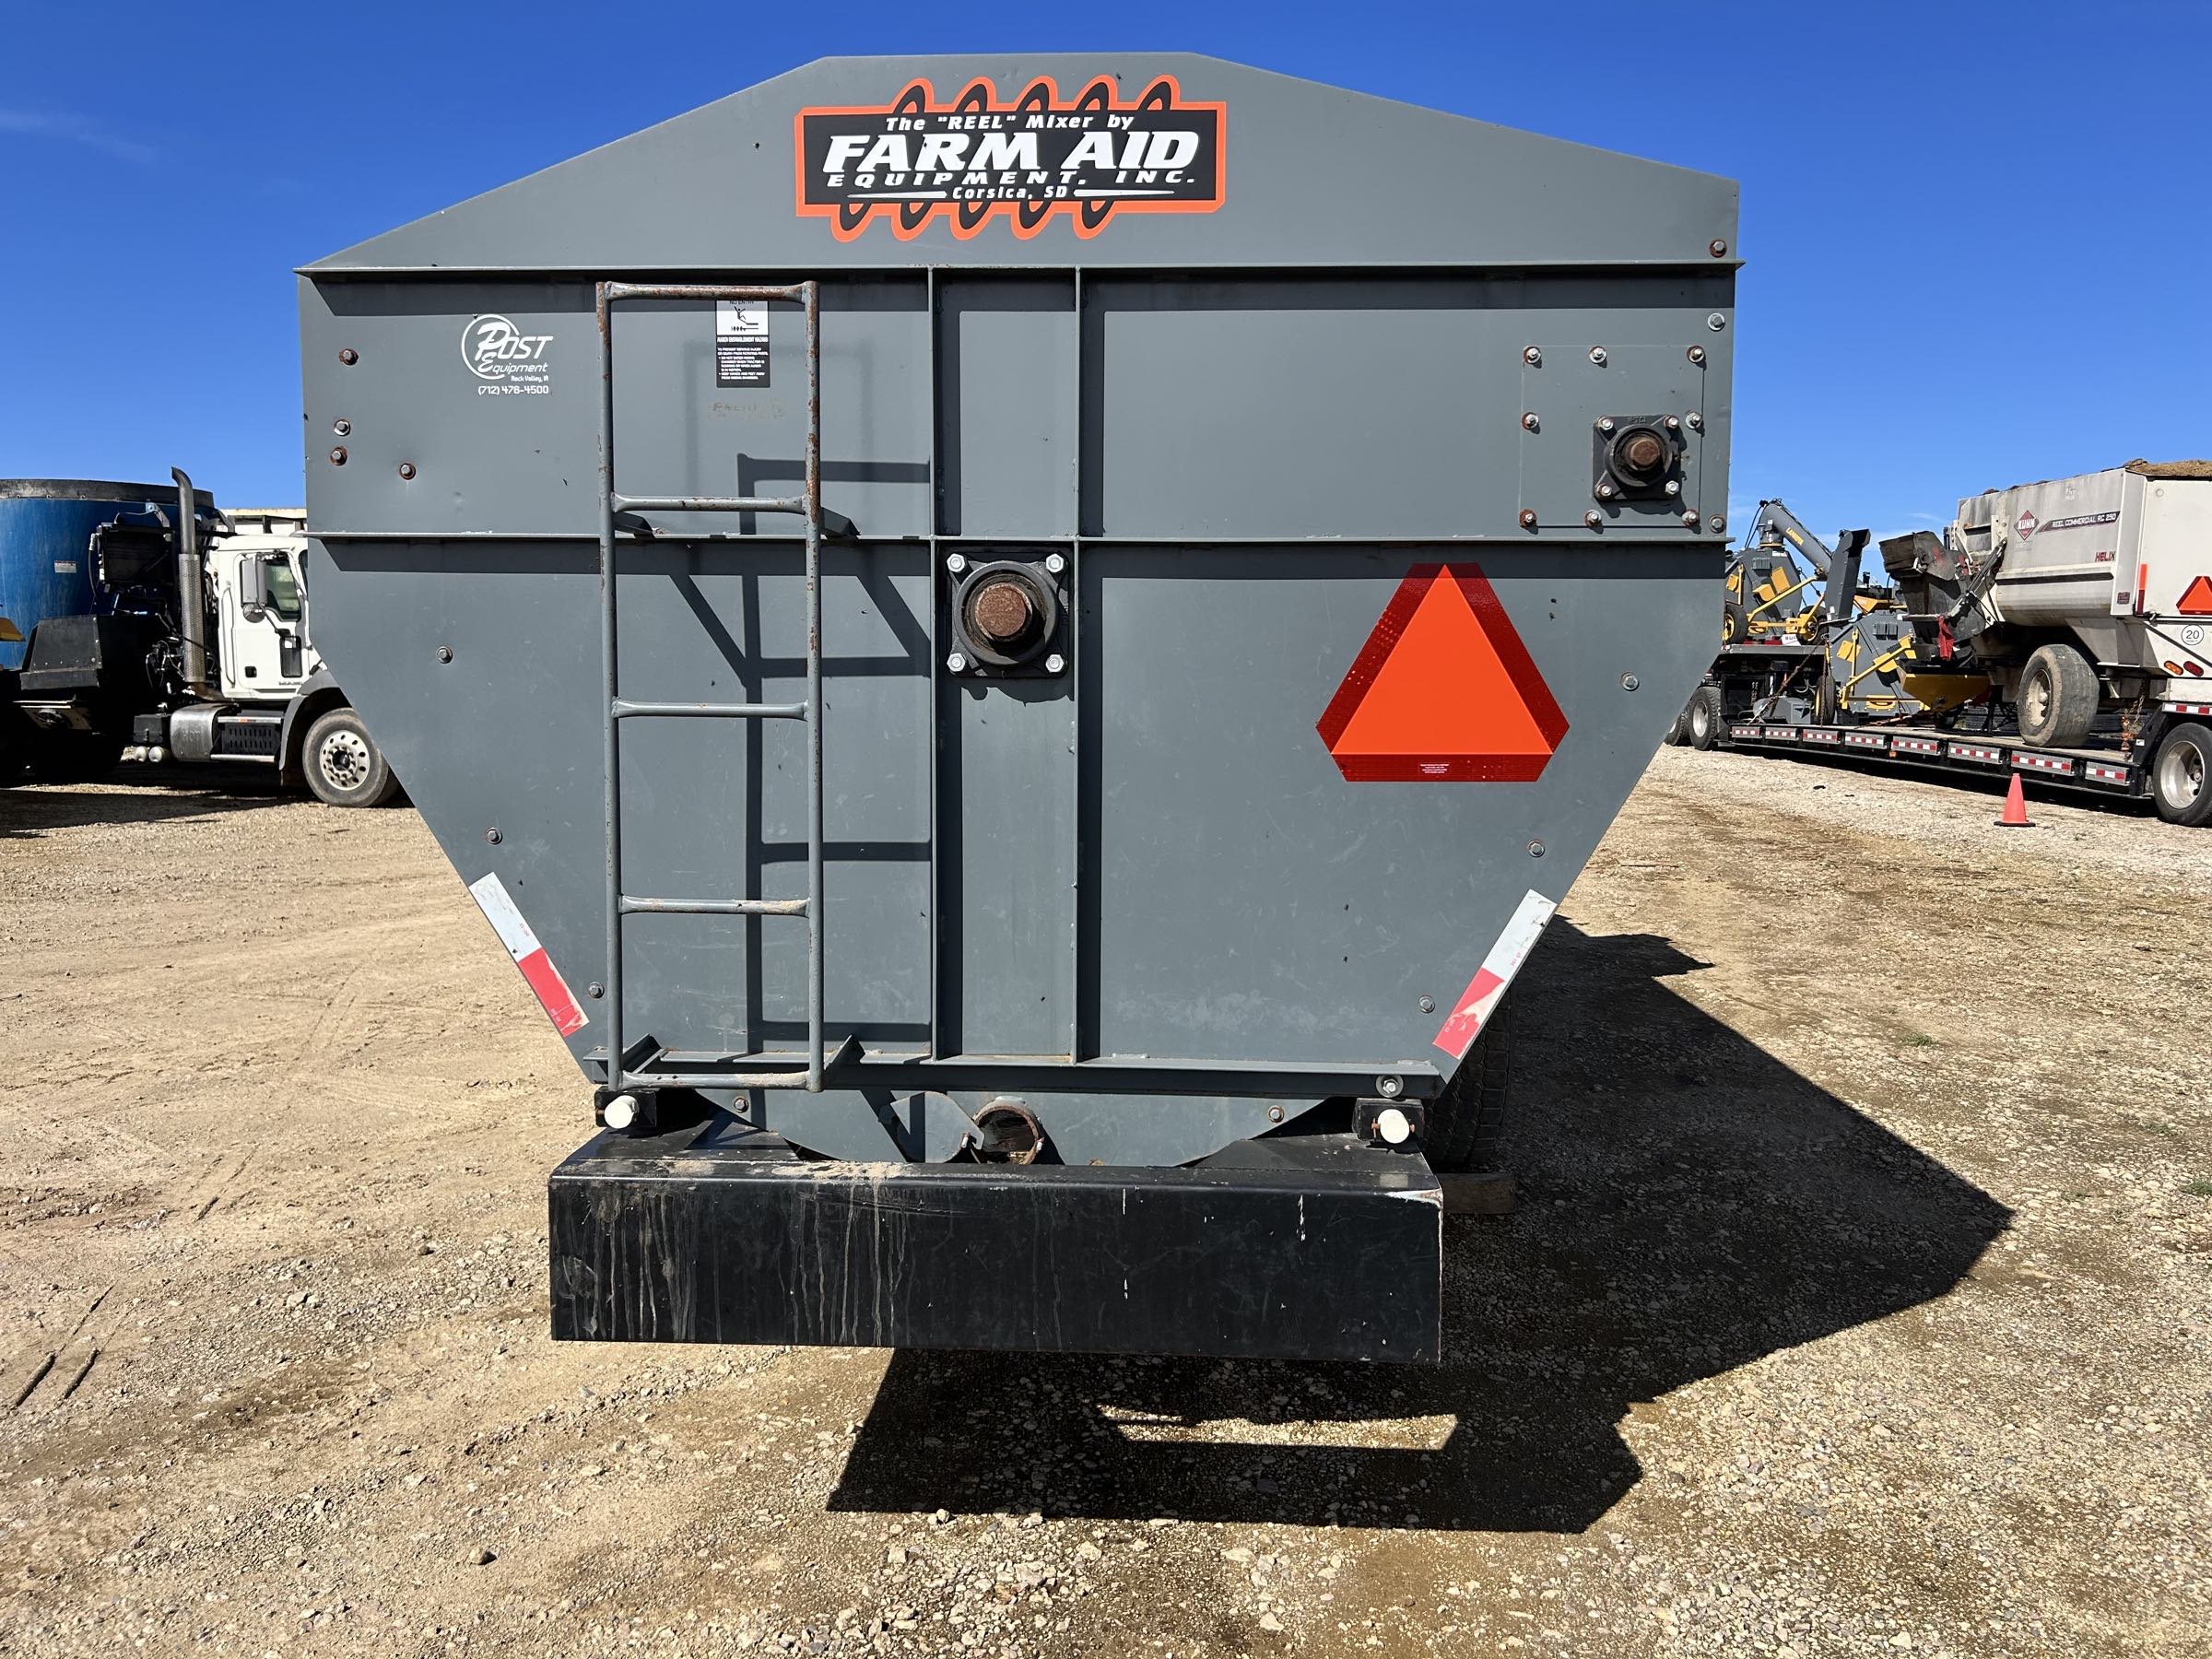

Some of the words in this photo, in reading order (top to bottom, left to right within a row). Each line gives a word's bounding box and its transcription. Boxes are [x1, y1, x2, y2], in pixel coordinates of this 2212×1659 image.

[887, 117, 925, 131] The
[937, 115, 1017, 130] "REEL"
[1026, 115, 1093, 128] Mixer
[1107, 114, 1134, 130] by
[823, 132, 1041, 173] FARM
[1061, 131, 1199, 170] AID
[1115, 171, 1194, 183] INC.
[953, 186, 1032, 200] Corsica,
[1044, 185, 1067, 198] SD
[477, 352, 547, 374] Equipment
[478, 385, 500, 395] (712)
[501, 385, 549, 394] 476-4500
[2018, 518, 2035, 530] KUHN
[2095, 551, 2116, 562] HELIX
[2185, 629, 2200, 640] 20
